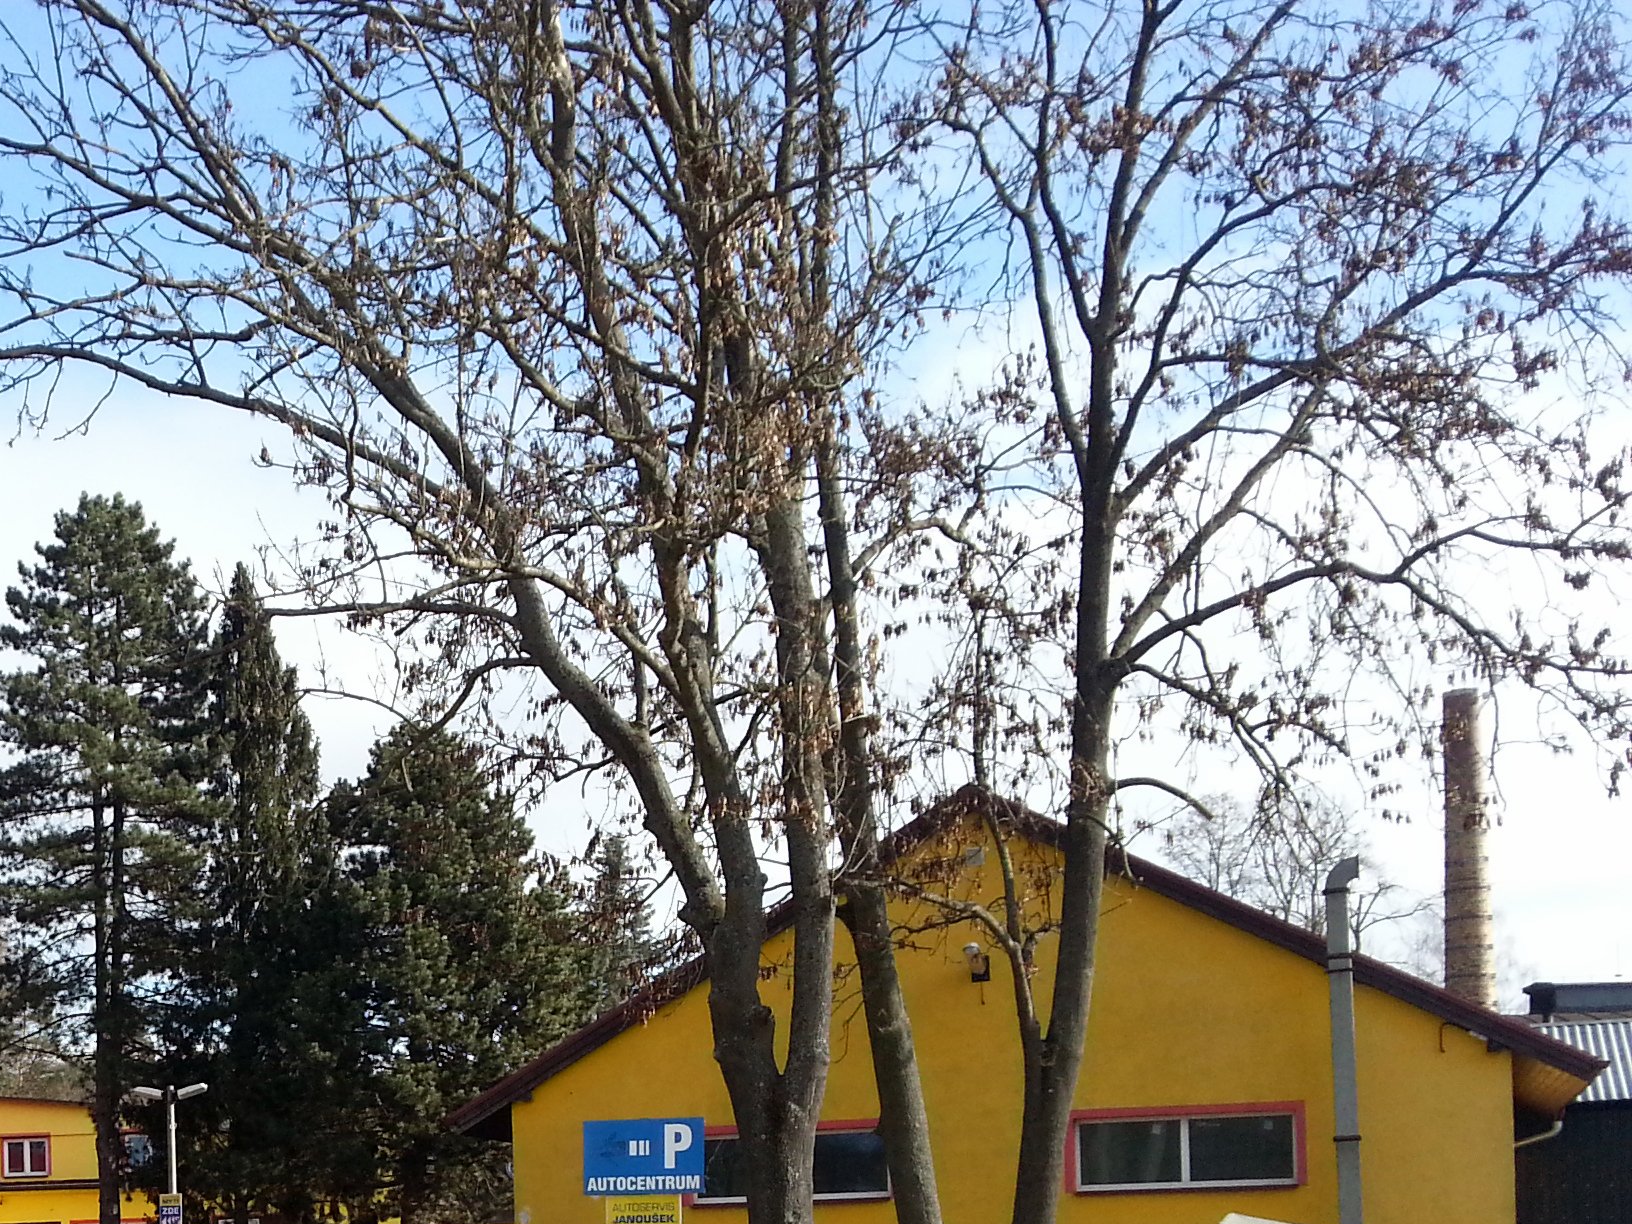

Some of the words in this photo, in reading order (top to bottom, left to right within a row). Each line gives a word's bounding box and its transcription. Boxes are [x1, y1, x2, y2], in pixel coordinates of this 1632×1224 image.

[663, 1123, 693, 1169] P
[587, 1174, 701, 1192] AUTOCENTRUM
[162, 1206, 180, 1215] ZDE
[612, 1202, 675, 1212] AUTOSERVIS
[612, 1213, 674, 1224] JANOUŠEK
